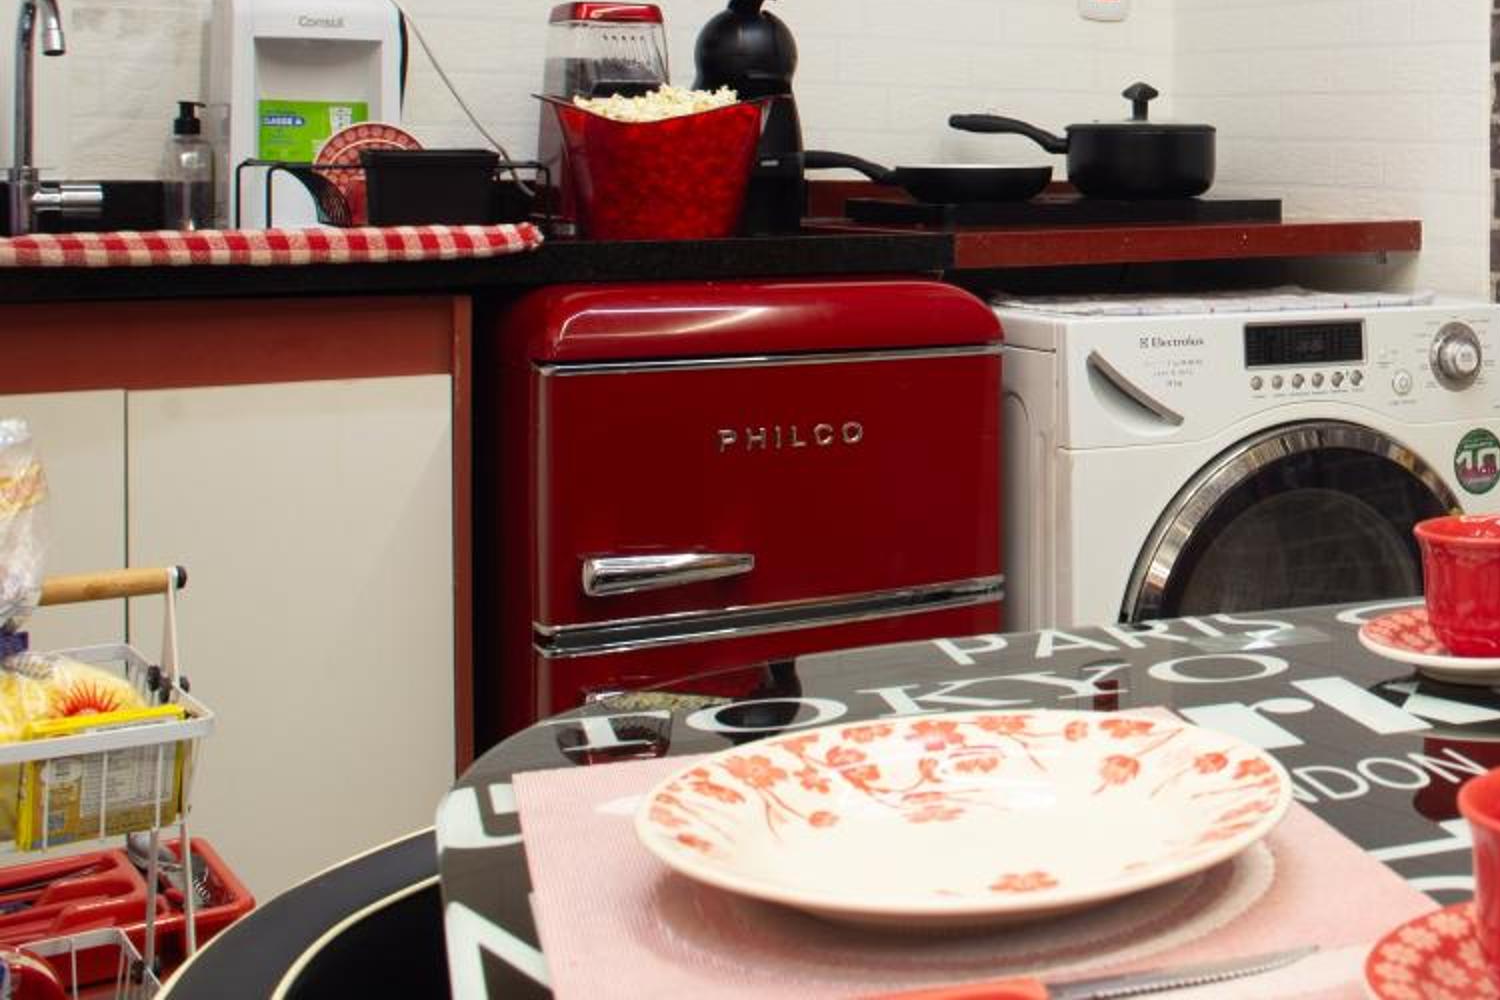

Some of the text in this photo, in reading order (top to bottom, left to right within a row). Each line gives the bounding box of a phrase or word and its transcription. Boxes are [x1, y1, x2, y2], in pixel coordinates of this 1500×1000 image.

[1151, 335, 1205, 348] Electrolux
[716, 419, 865, 454] PHILCO
[931, 611, 1295, 667] PARIS
[543, 652, 1290, 752] TOKYO
